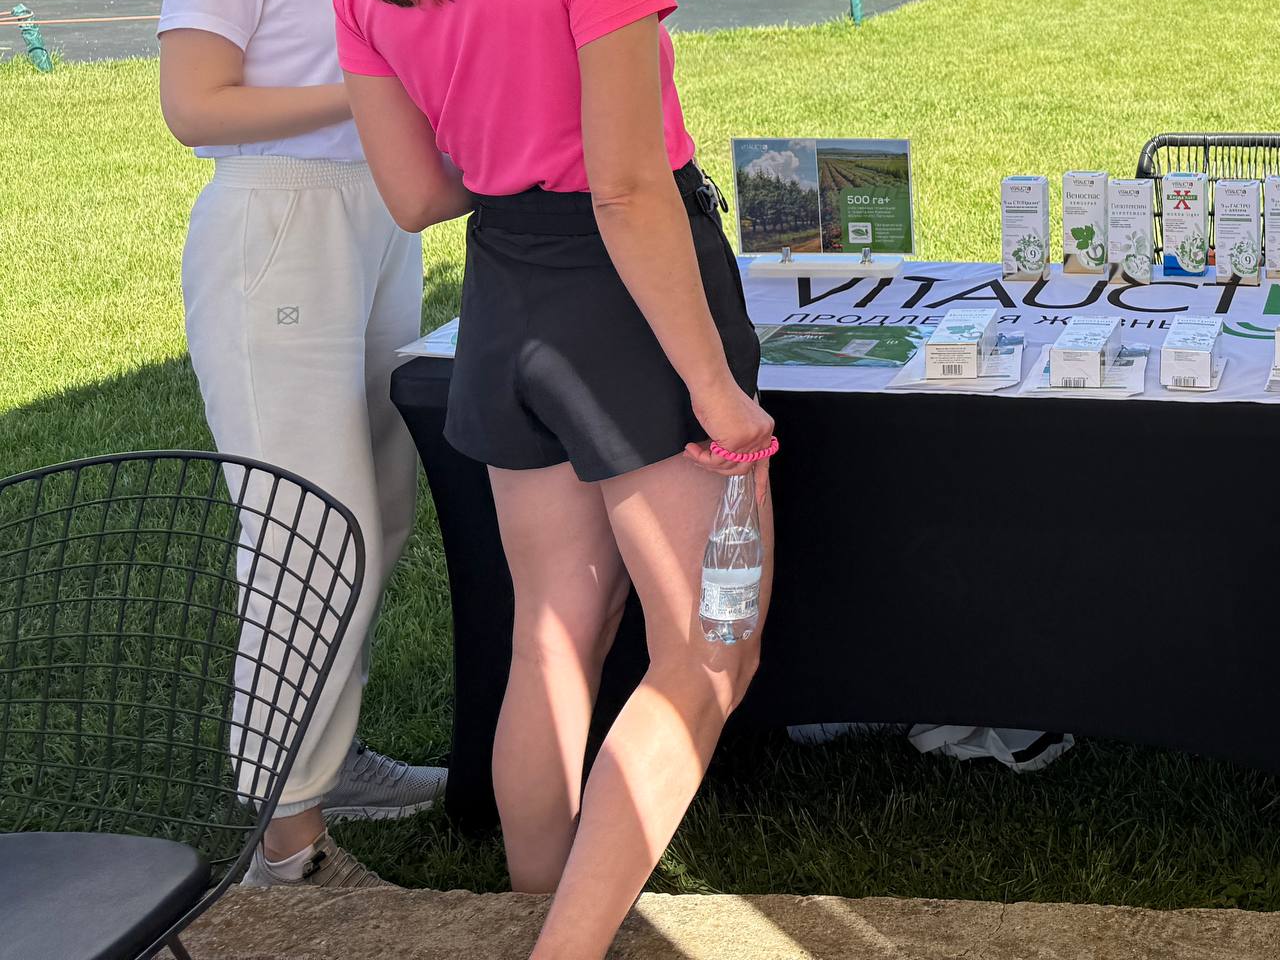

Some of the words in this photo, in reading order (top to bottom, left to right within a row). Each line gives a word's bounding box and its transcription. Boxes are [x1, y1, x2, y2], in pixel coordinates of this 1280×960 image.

[847, 195, 870, 205] 500
[872, 196, 891, 205] га+
[797, 275, 1260, 314] VITAUCT
[782, 313, 1022, 326] ПРОДЛЕЯ
[1033, 315, 1172, 330] ЖНЬ
